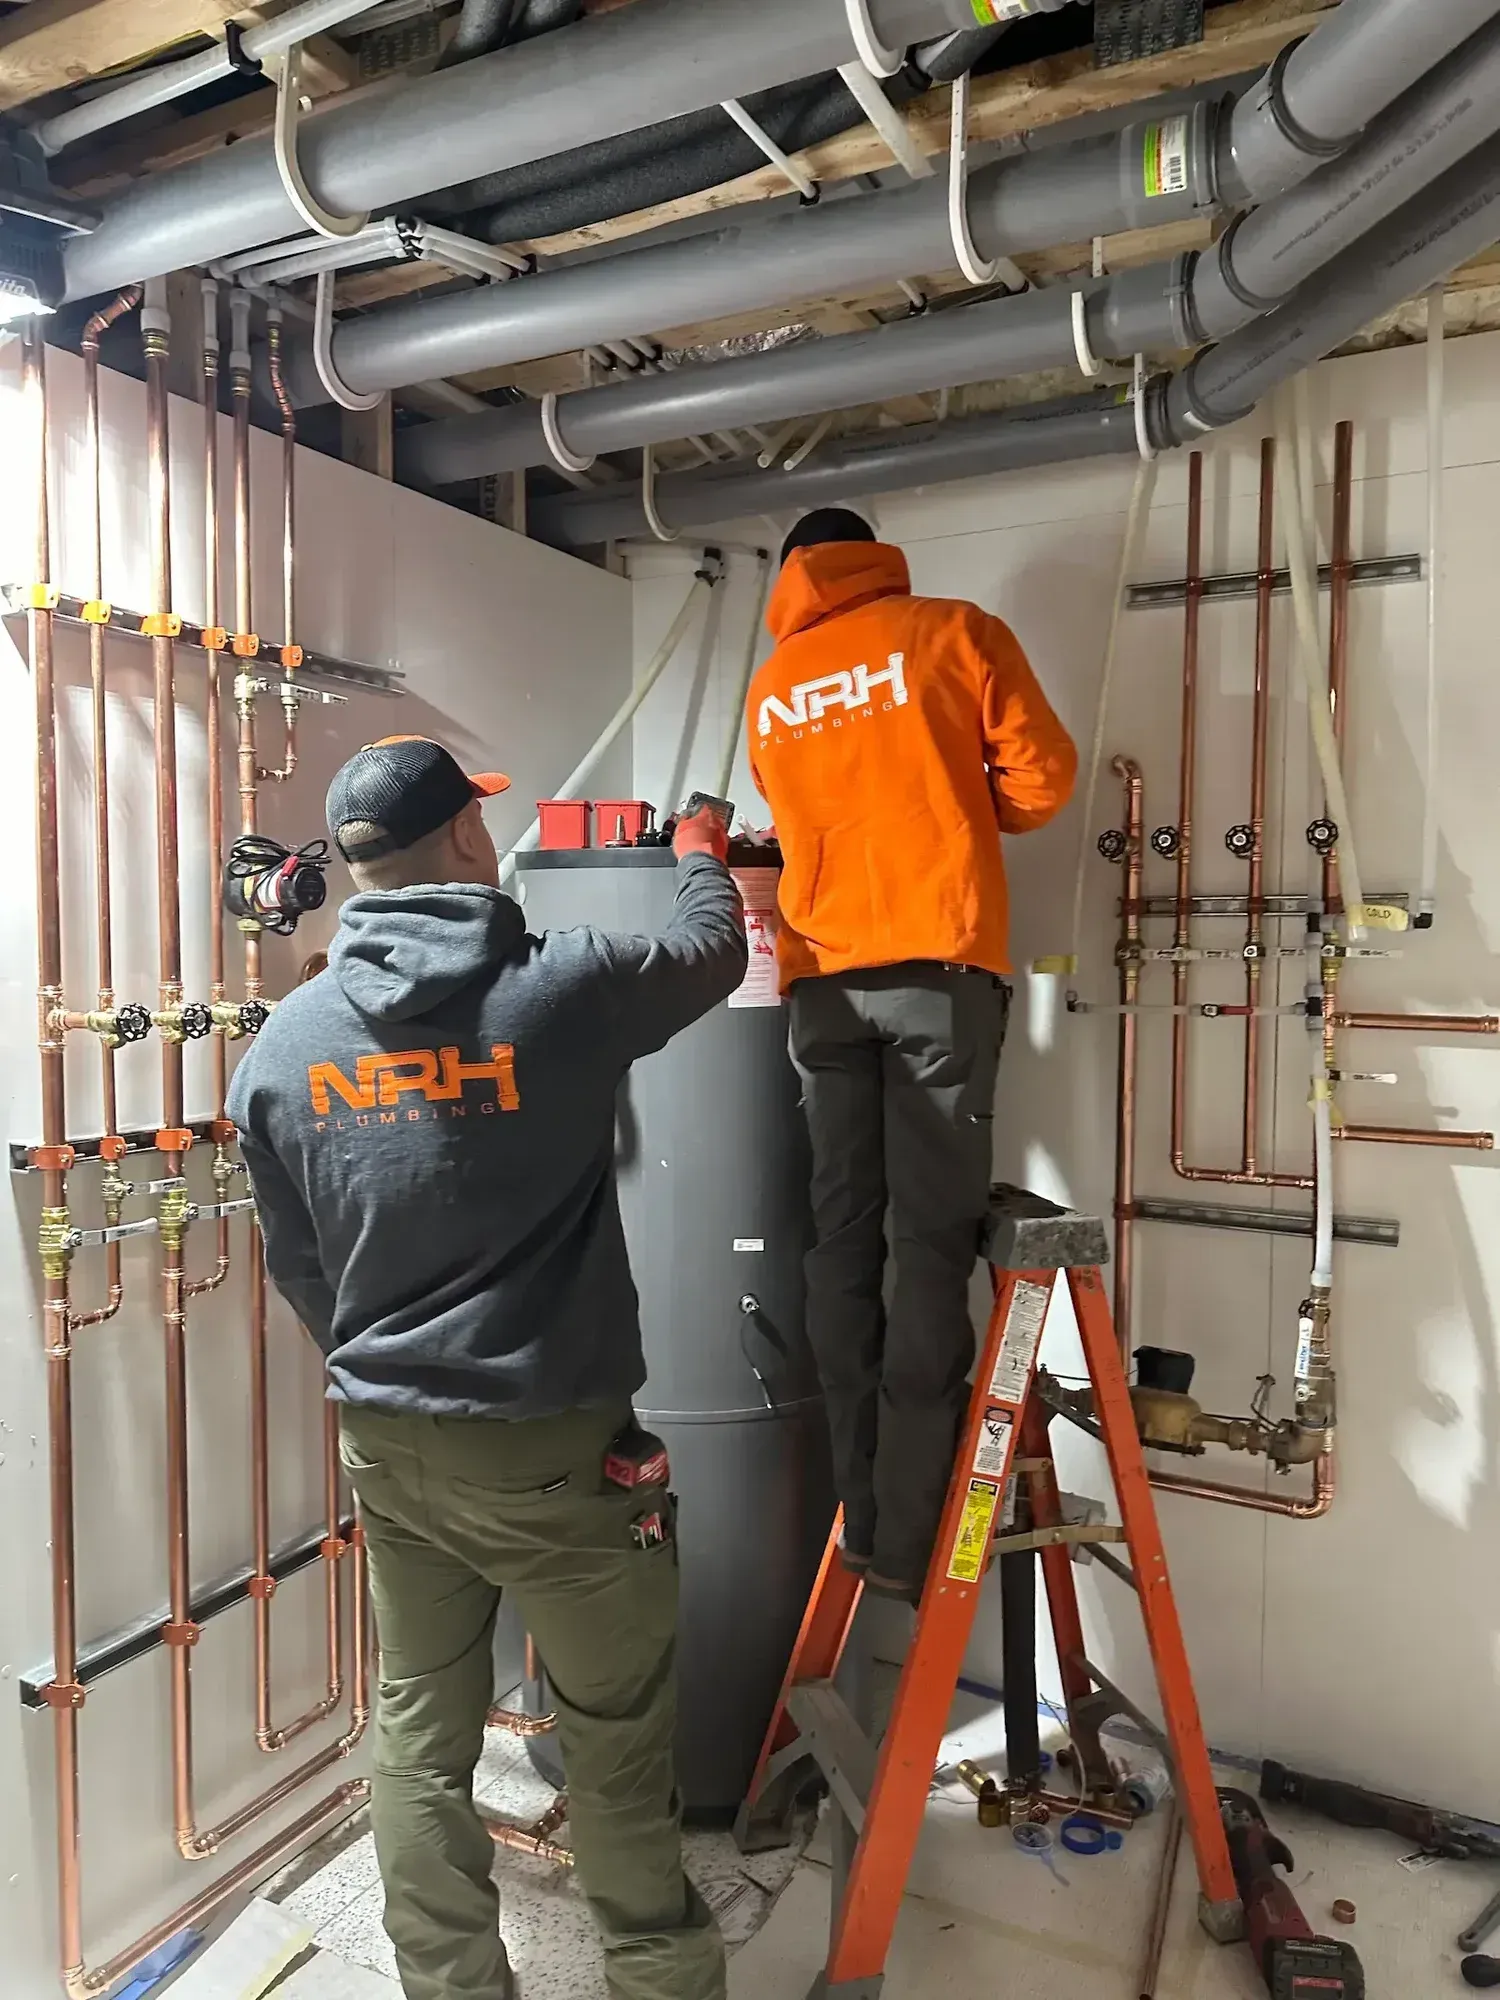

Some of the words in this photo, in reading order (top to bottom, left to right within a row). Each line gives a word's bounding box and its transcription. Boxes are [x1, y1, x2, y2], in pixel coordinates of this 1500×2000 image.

[0, 278, 26, 295] ita
[757, 651, 908, 737] NRH
[759, 702, 894, 751] PLUMBING
[1366, 907, 1391, 919] COLD
[306, 1043, 520, 1115] NRH
[314, 1102, 496, 1134] PLUMBING
